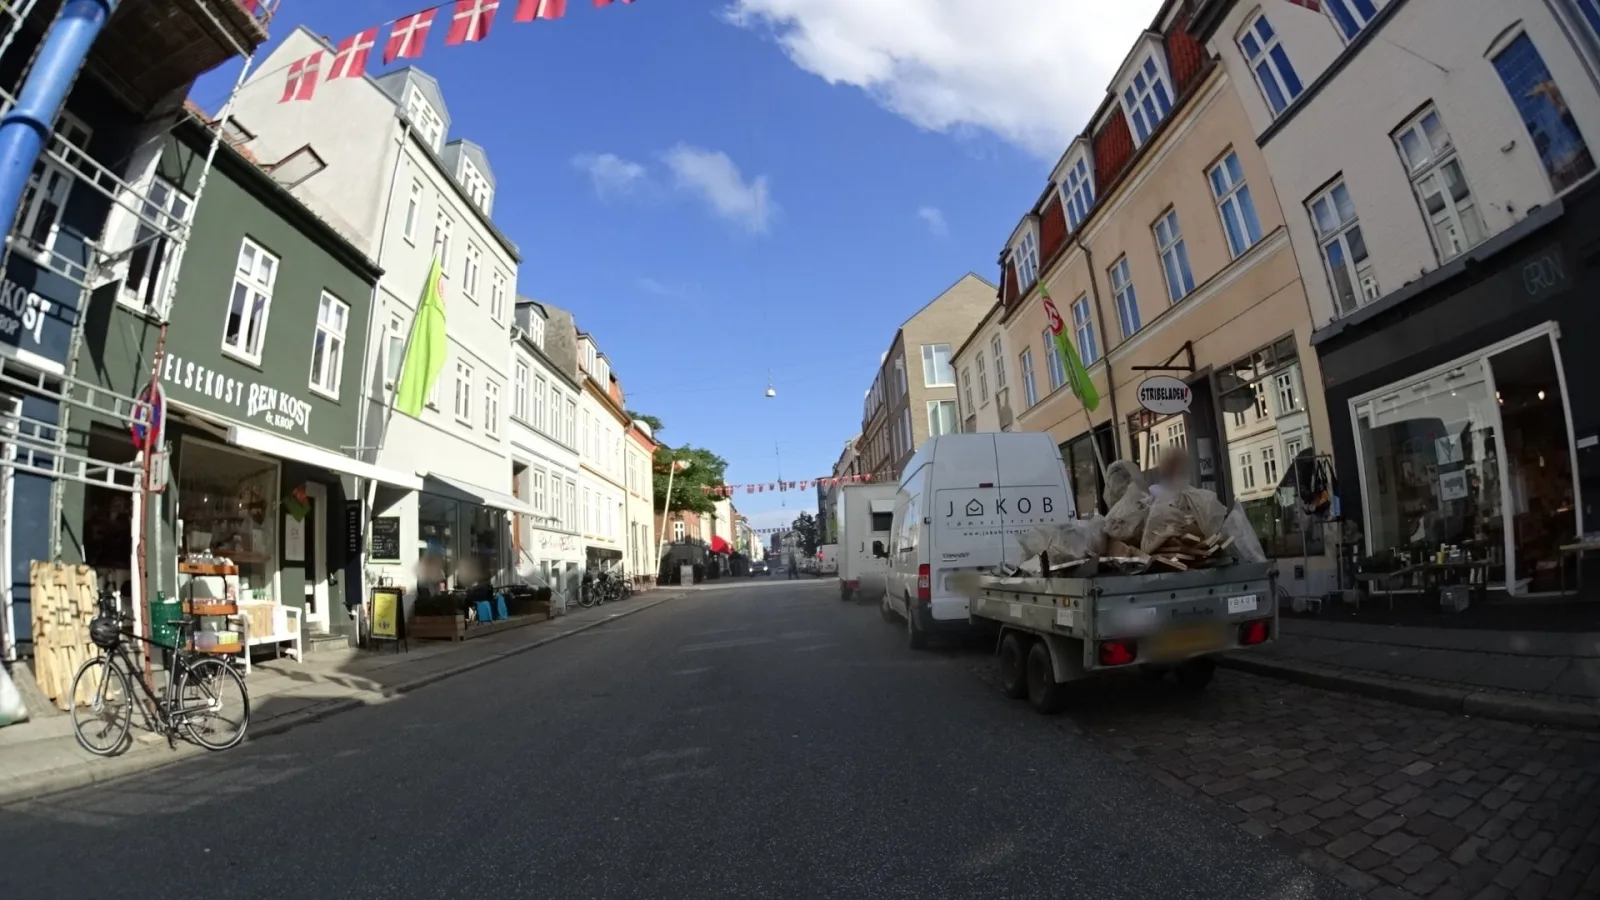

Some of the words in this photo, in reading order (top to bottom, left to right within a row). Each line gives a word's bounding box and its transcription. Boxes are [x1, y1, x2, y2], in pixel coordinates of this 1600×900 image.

[1140, 387, 1189, 404] STRIBELADEN!
[247, 383, 278, 417] REN
[279, 392, 312, 435] KOST
[275, 414, 295, 431] KROP
